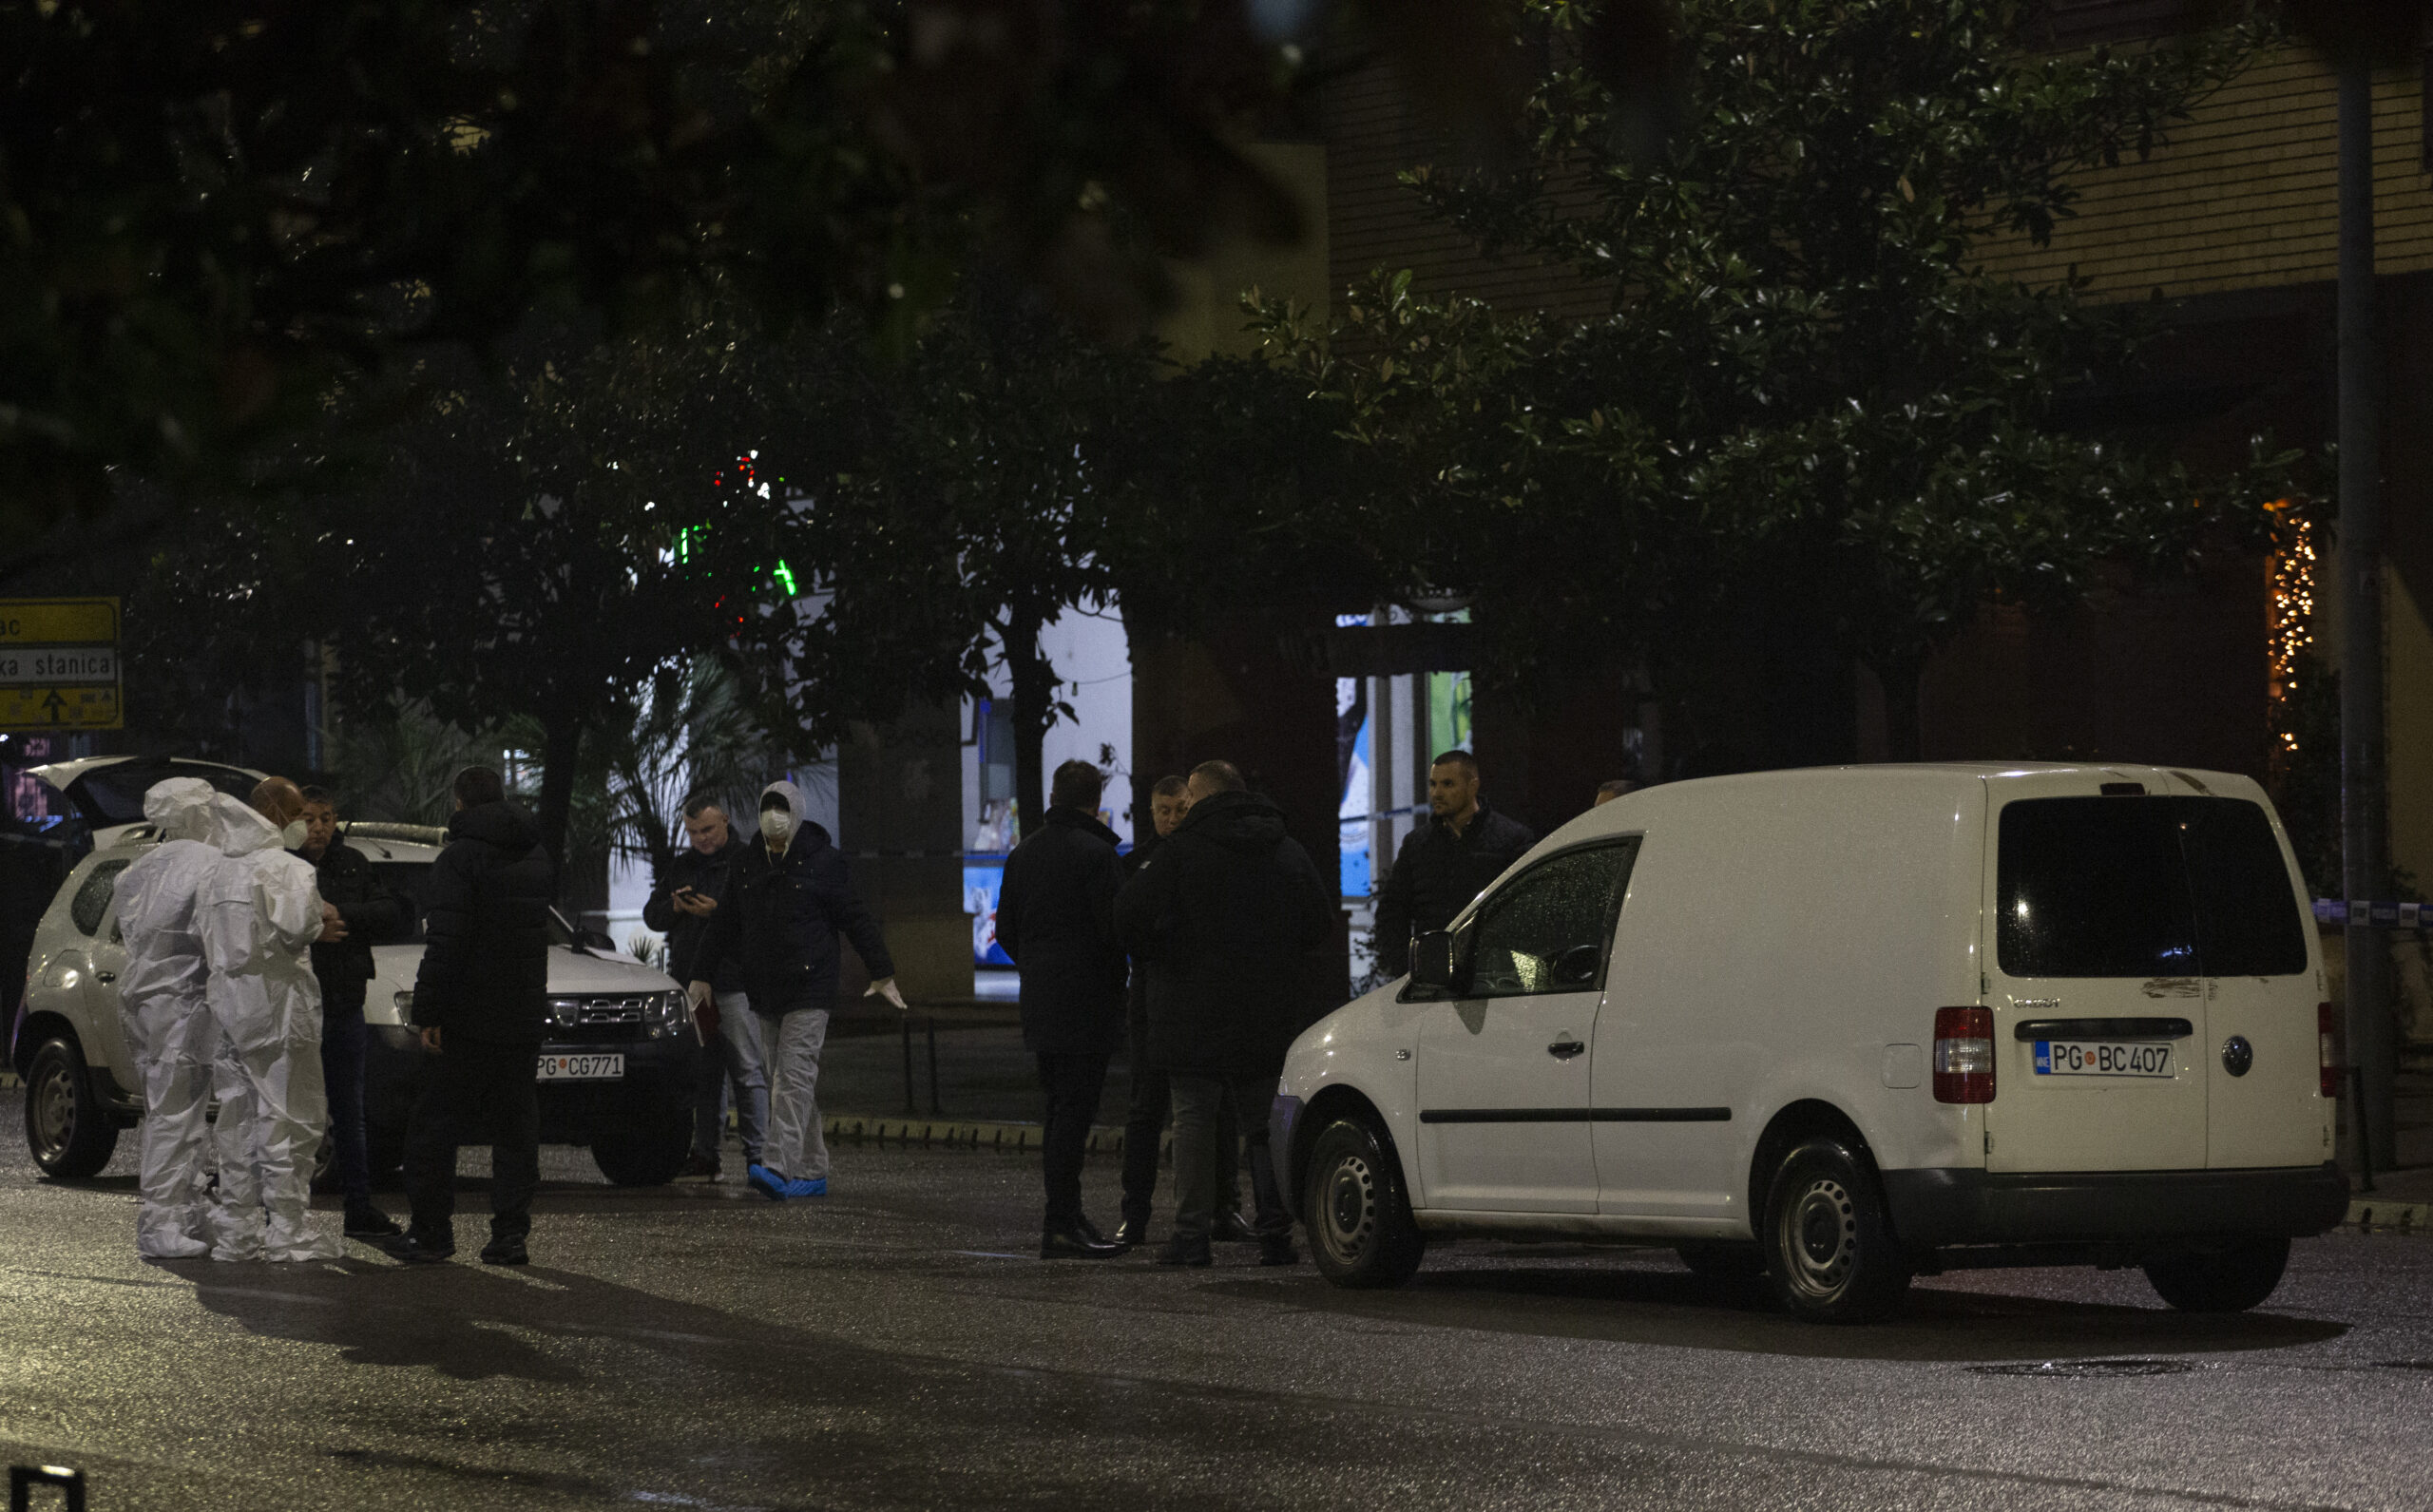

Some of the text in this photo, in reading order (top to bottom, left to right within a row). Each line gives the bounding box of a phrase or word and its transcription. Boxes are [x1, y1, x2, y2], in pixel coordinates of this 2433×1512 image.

[36, 654, 109, 675] stanica
[538, 1057, 621, 1075] PG CG771
[2054, 1044, 2169, 1073] PG BC407
